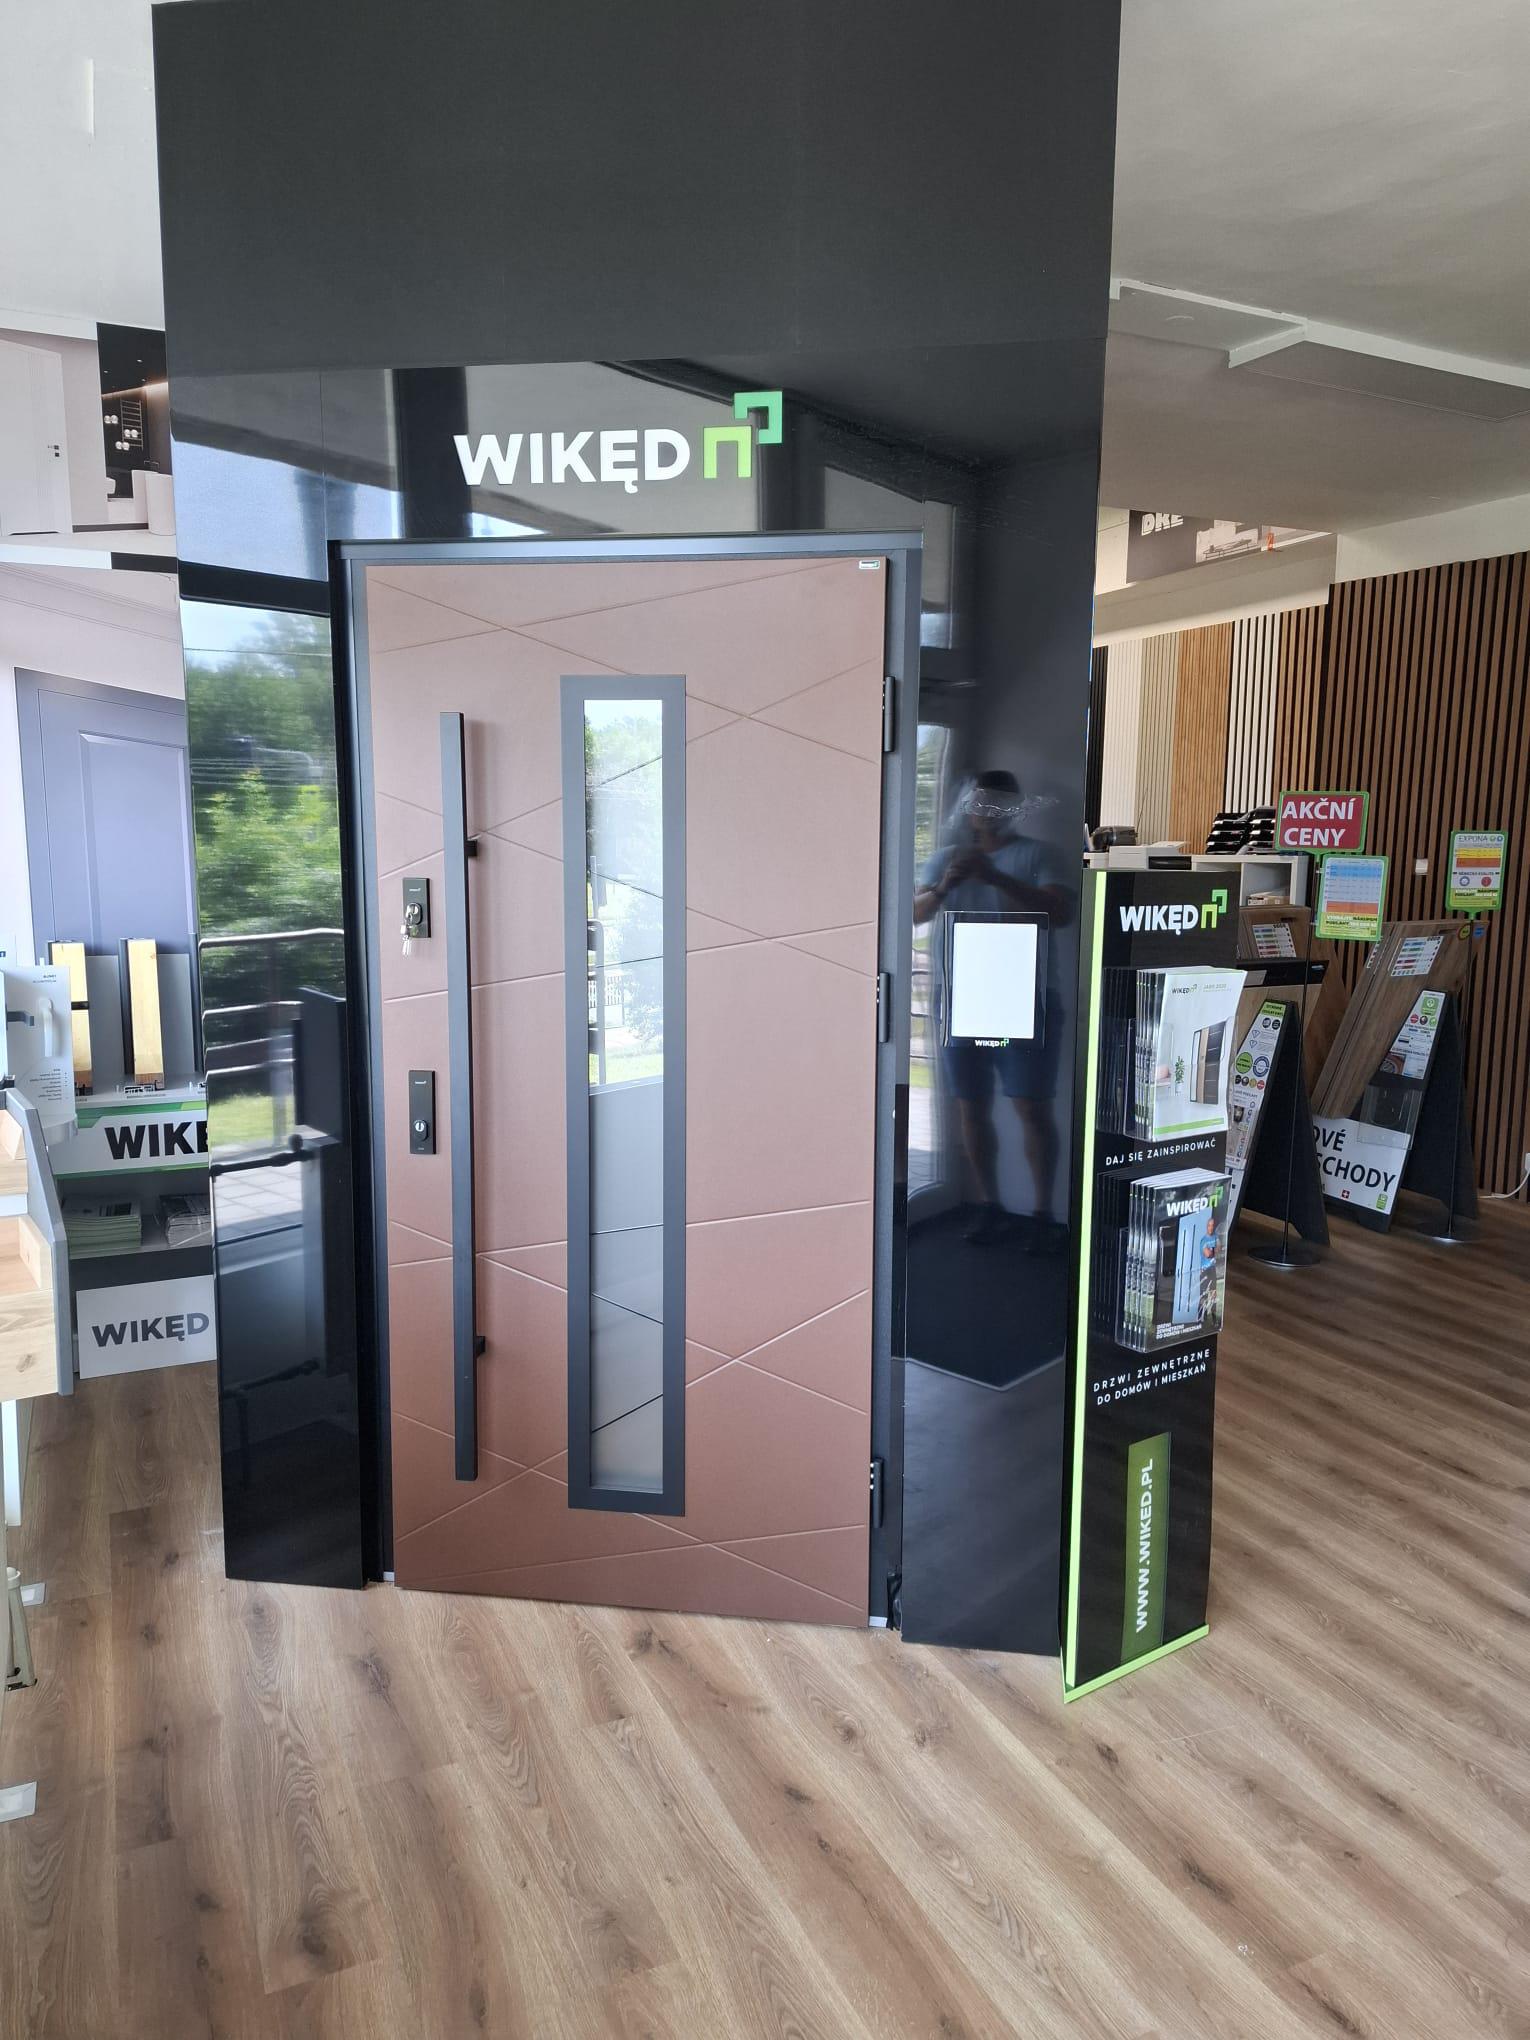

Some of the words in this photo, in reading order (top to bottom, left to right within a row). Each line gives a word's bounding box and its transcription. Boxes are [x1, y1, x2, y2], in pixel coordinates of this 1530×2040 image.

[453, 429, 691, 494] WIKĘD
[1282, 798, 1356, 820] AKČNÍ
[1284, 827, 1346, 847] CENY
[1119, 904, 1199, 936] WIKĘD
[1105, 1154, 1125, 1166] DAJ
[1128, 1151, 1143, 1163] SIĘ
[1147, 1137, 1217, 1159] ZAINSPIROWAĆ
[92, 1312, 210, 1348] WIKĘD
[1093, 1372, 1131, 1392] DRZWI
[1137, 1348, 1210, 1379] ZEWNĘTRZNE
[1097, 1393, 1111, 1405] DO
[1115, 1380, 1151, 1400] DOMÓW
[1154, 1378, 1158, 1387] I
[1161, 1362, 1206, 1385] MIESZKAŃ
